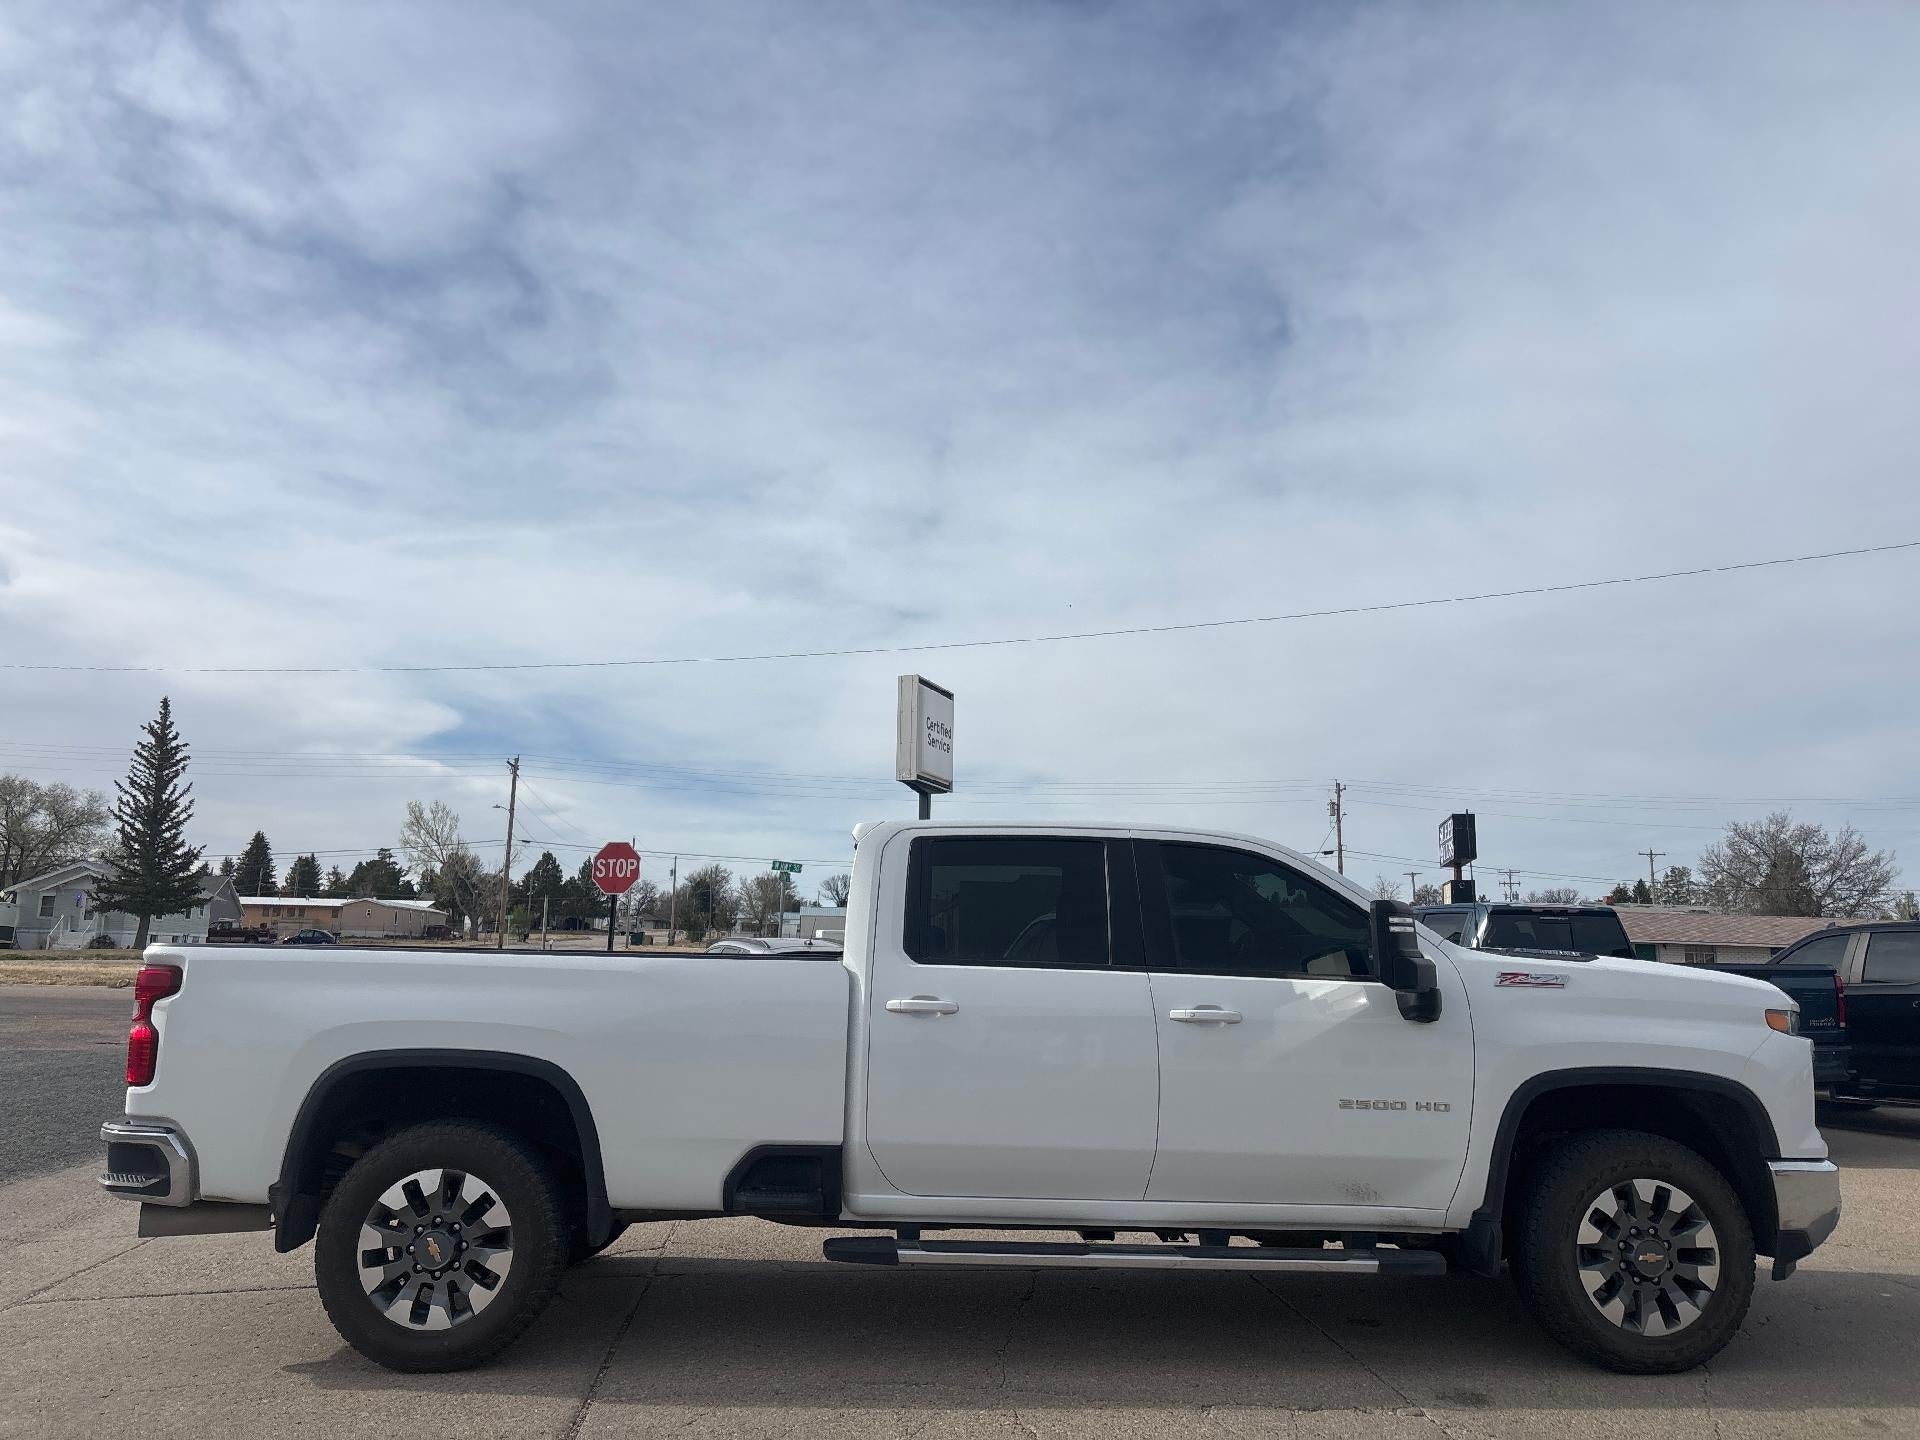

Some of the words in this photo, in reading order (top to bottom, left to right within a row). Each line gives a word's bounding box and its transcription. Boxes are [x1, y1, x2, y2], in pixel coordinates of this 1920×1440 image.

[926, 716, 952, 740] Certified
[927, 733, 951, 754] Service
[595, 858, 638, 878] STOP
[1339, 1099, 1407, 1111] 2500
[1415, 1101, 1451, 1112] HD
